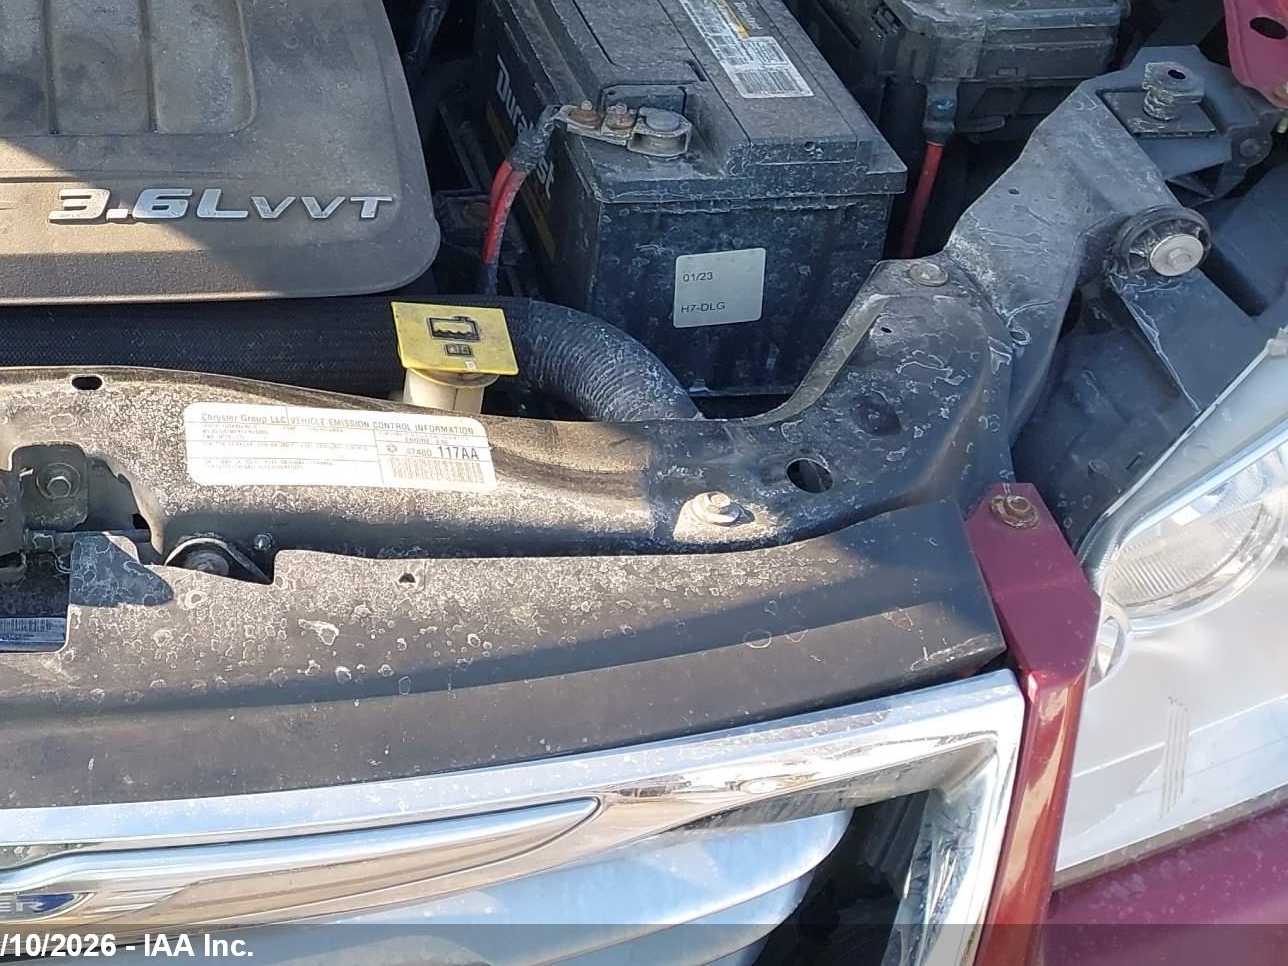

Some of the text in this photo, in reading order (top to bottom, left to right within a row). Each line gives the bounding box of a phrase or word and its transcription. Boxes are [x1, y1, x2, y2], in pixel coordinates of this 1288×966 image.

[496, 53, 555, 200] Durast
[251, 195, 394, 220] VVT
[682, 271, 713, 283] 01/23
[680, 301, 726, 314] H7-DLG
[240, 414, 267, 424] Group
[270, 415, 286, 424] LLC
[288, 416, 474, 435] VEHICLE EMISSION CONTROL INFORMATION
[437, 445, 480, 460] 117AA
